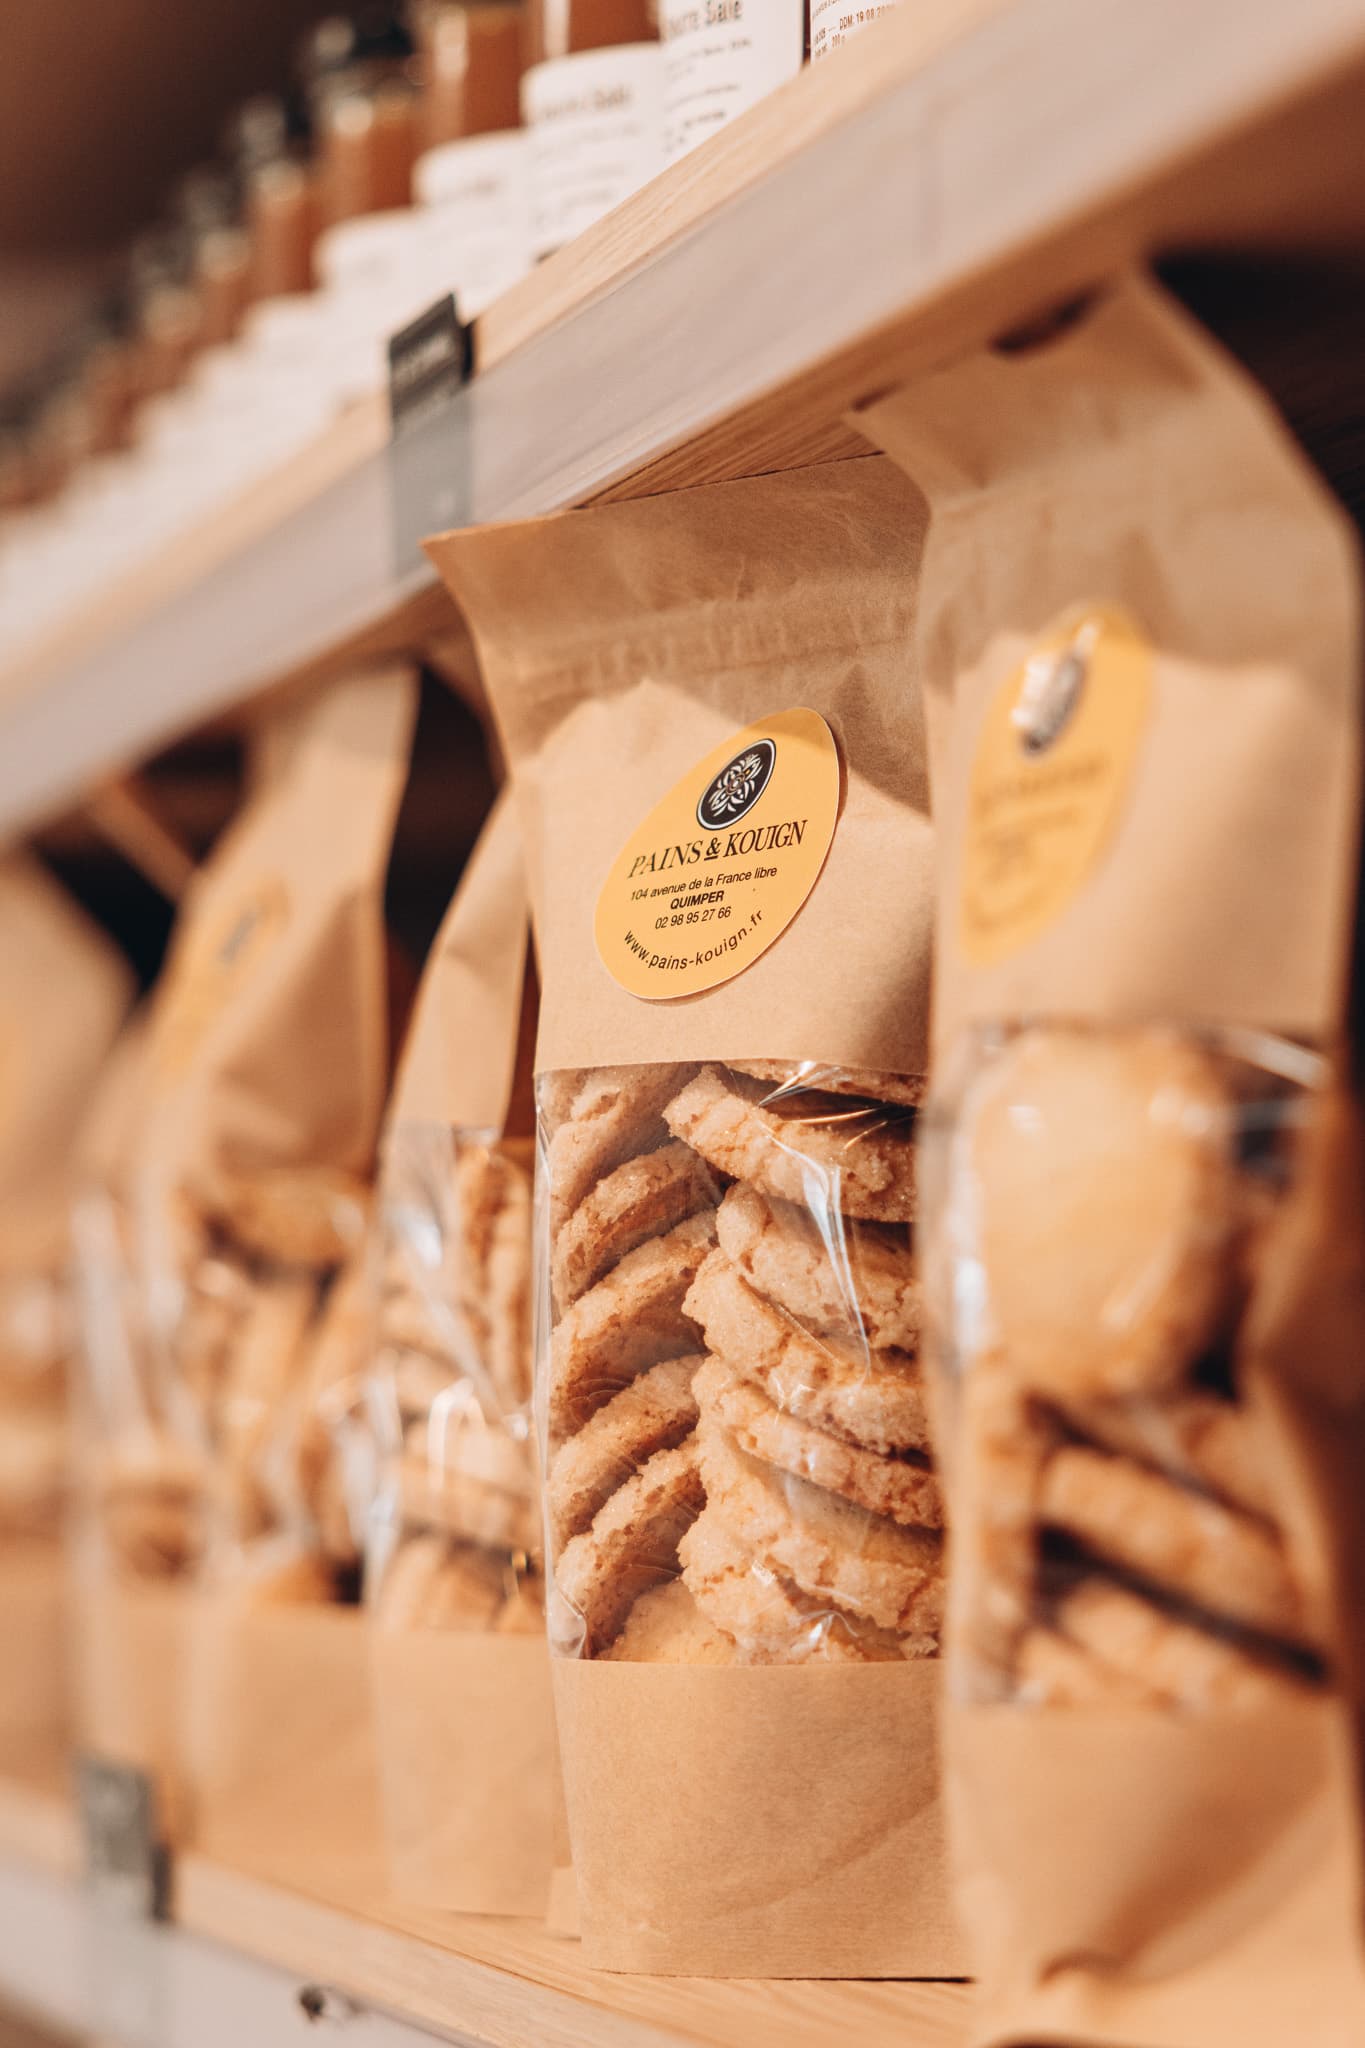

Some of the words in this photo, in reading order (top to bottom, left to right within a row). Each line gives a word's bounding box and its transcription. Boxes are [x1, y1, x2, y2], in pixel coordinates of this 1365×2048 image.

[628, 840, 704, 879] PAINS
[704, 837, 722, 861] &
[723, 819, 808, 858] KOUIGN
[631, 888, 649, 901] 104
[650, 882, 687, 898] avenue
[688, 879, 701, 891] de
[704, 876, 713, 888] la
[716, 871, 752, 886] France
[754, 866, 778, 880] libre
[670, 890, 725, 910] QUIMPER
[655, 916, 668, 930] 02
[670, 914, 684, 927] 98
[686, 911, 700, 924] 95
[701, 908, 716, 922] 27
[718, 906, 731, 919] 66
[624, 909, 763, 971] www.pains-kouign.fr
